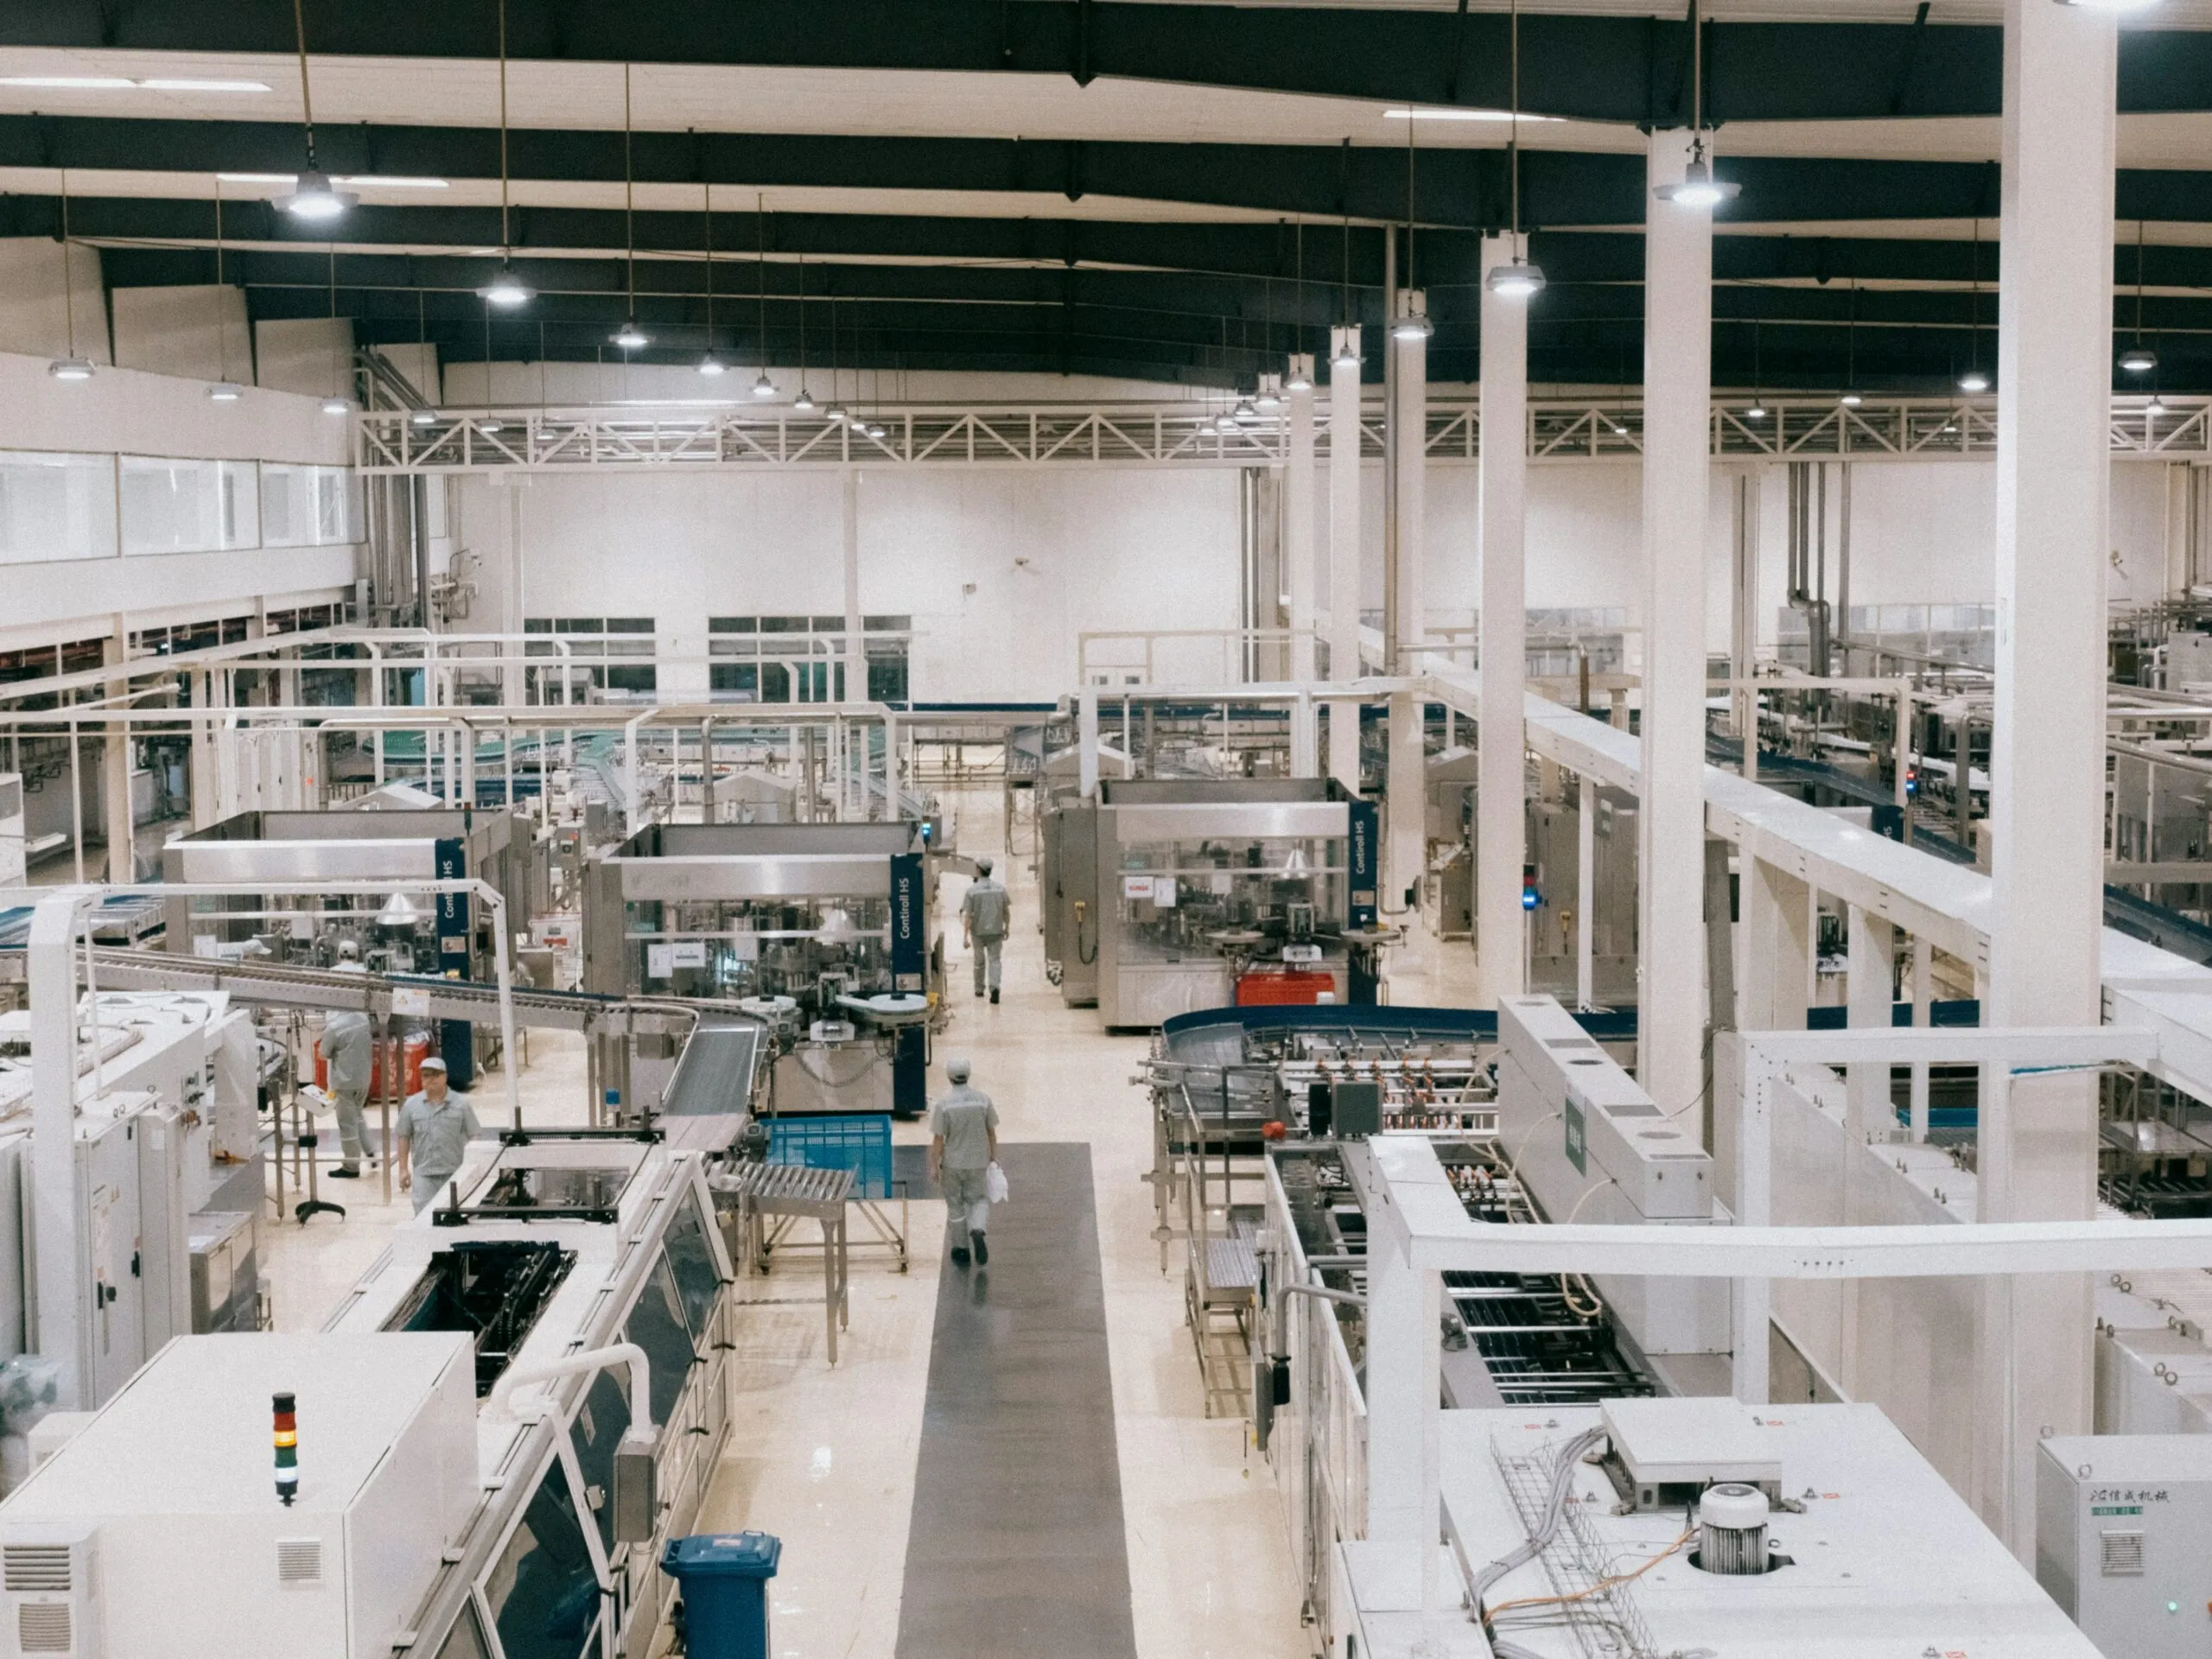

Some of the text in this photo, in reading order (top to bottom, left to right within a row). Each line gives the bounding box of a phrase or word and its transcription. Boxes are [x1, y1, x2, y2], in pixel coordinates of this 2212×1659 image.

[1355, 820, 1364, 834] HS
[442, 860, 453, 874] HS
[899, 877, 910, 939] Contiroll HS
